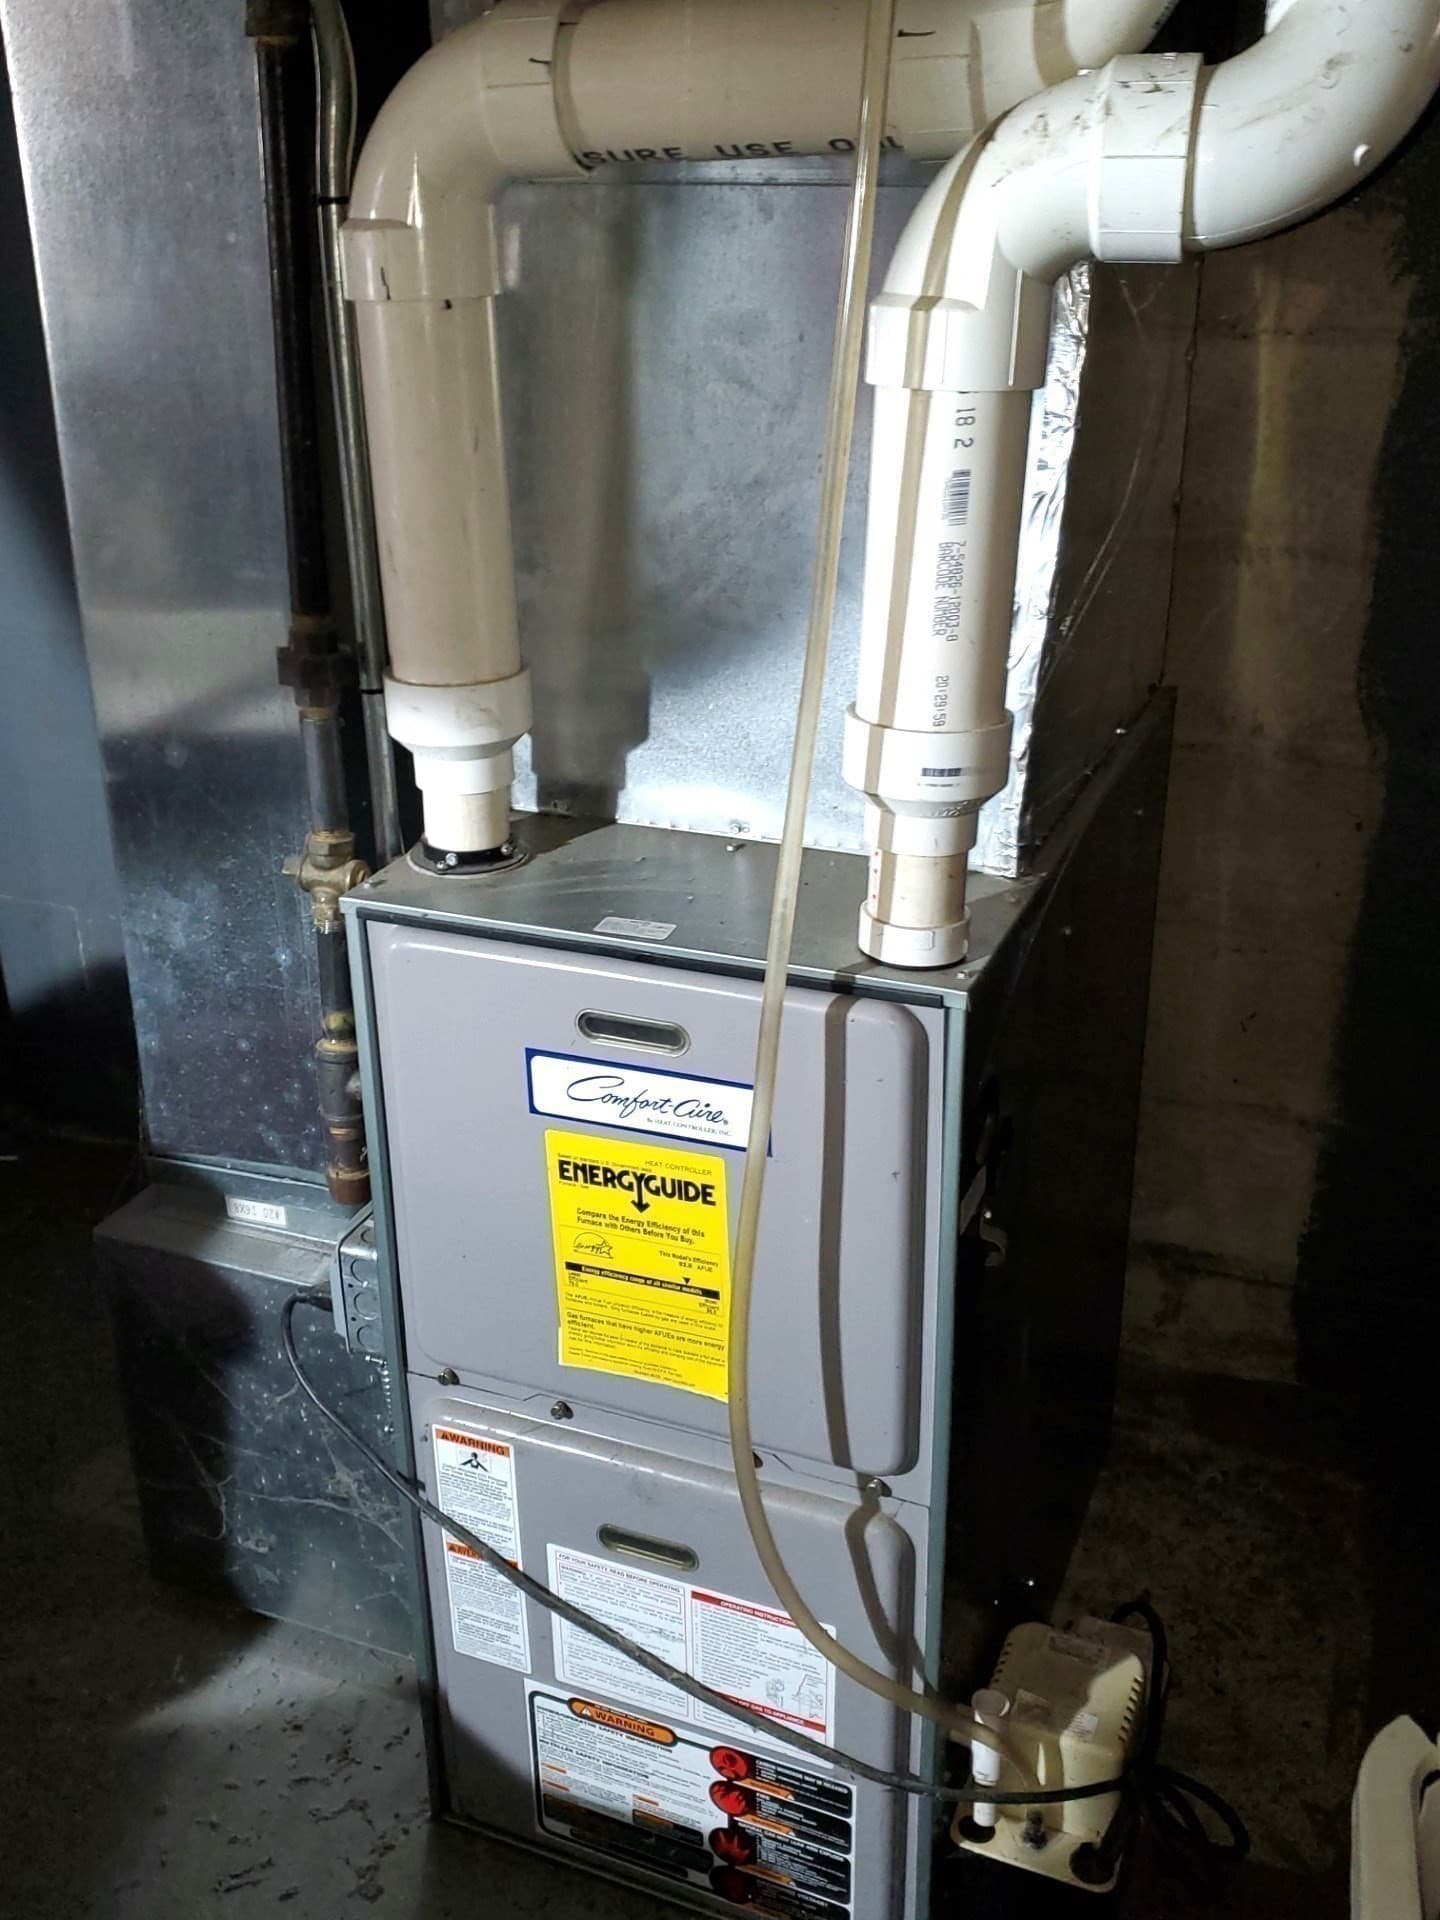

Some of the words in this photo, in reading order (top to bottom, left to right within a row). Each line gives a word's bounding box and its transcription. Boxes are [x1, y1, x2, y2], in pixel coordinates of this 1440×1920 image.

[714, 141, 794, 158] USE
[953, 437, 974, 449] 2
[558, 1159, 716, 1206] ENERGYGUIDE
[577, 1208, 607, 1220] Compare
[608, 1211, 619, 1222] the
[621, 1216, 644, 1227] Energy
[647, 1220, 681, 1235] Efficiency
[682, 1227, 691, 1235] of
[692, 1229, 705, 1238] this
[577, 1216, 602, 1228] Furnace
[604, 1221, 618, 1230] with
[620, 1225, 641, 1234] Others
[643, 1229, 664, 1239] Before
[666, 1232, 679, 1242] You
[680, 1236, 695, 1246] Buy.
[594, 1710, 655, 1737] WARNING
